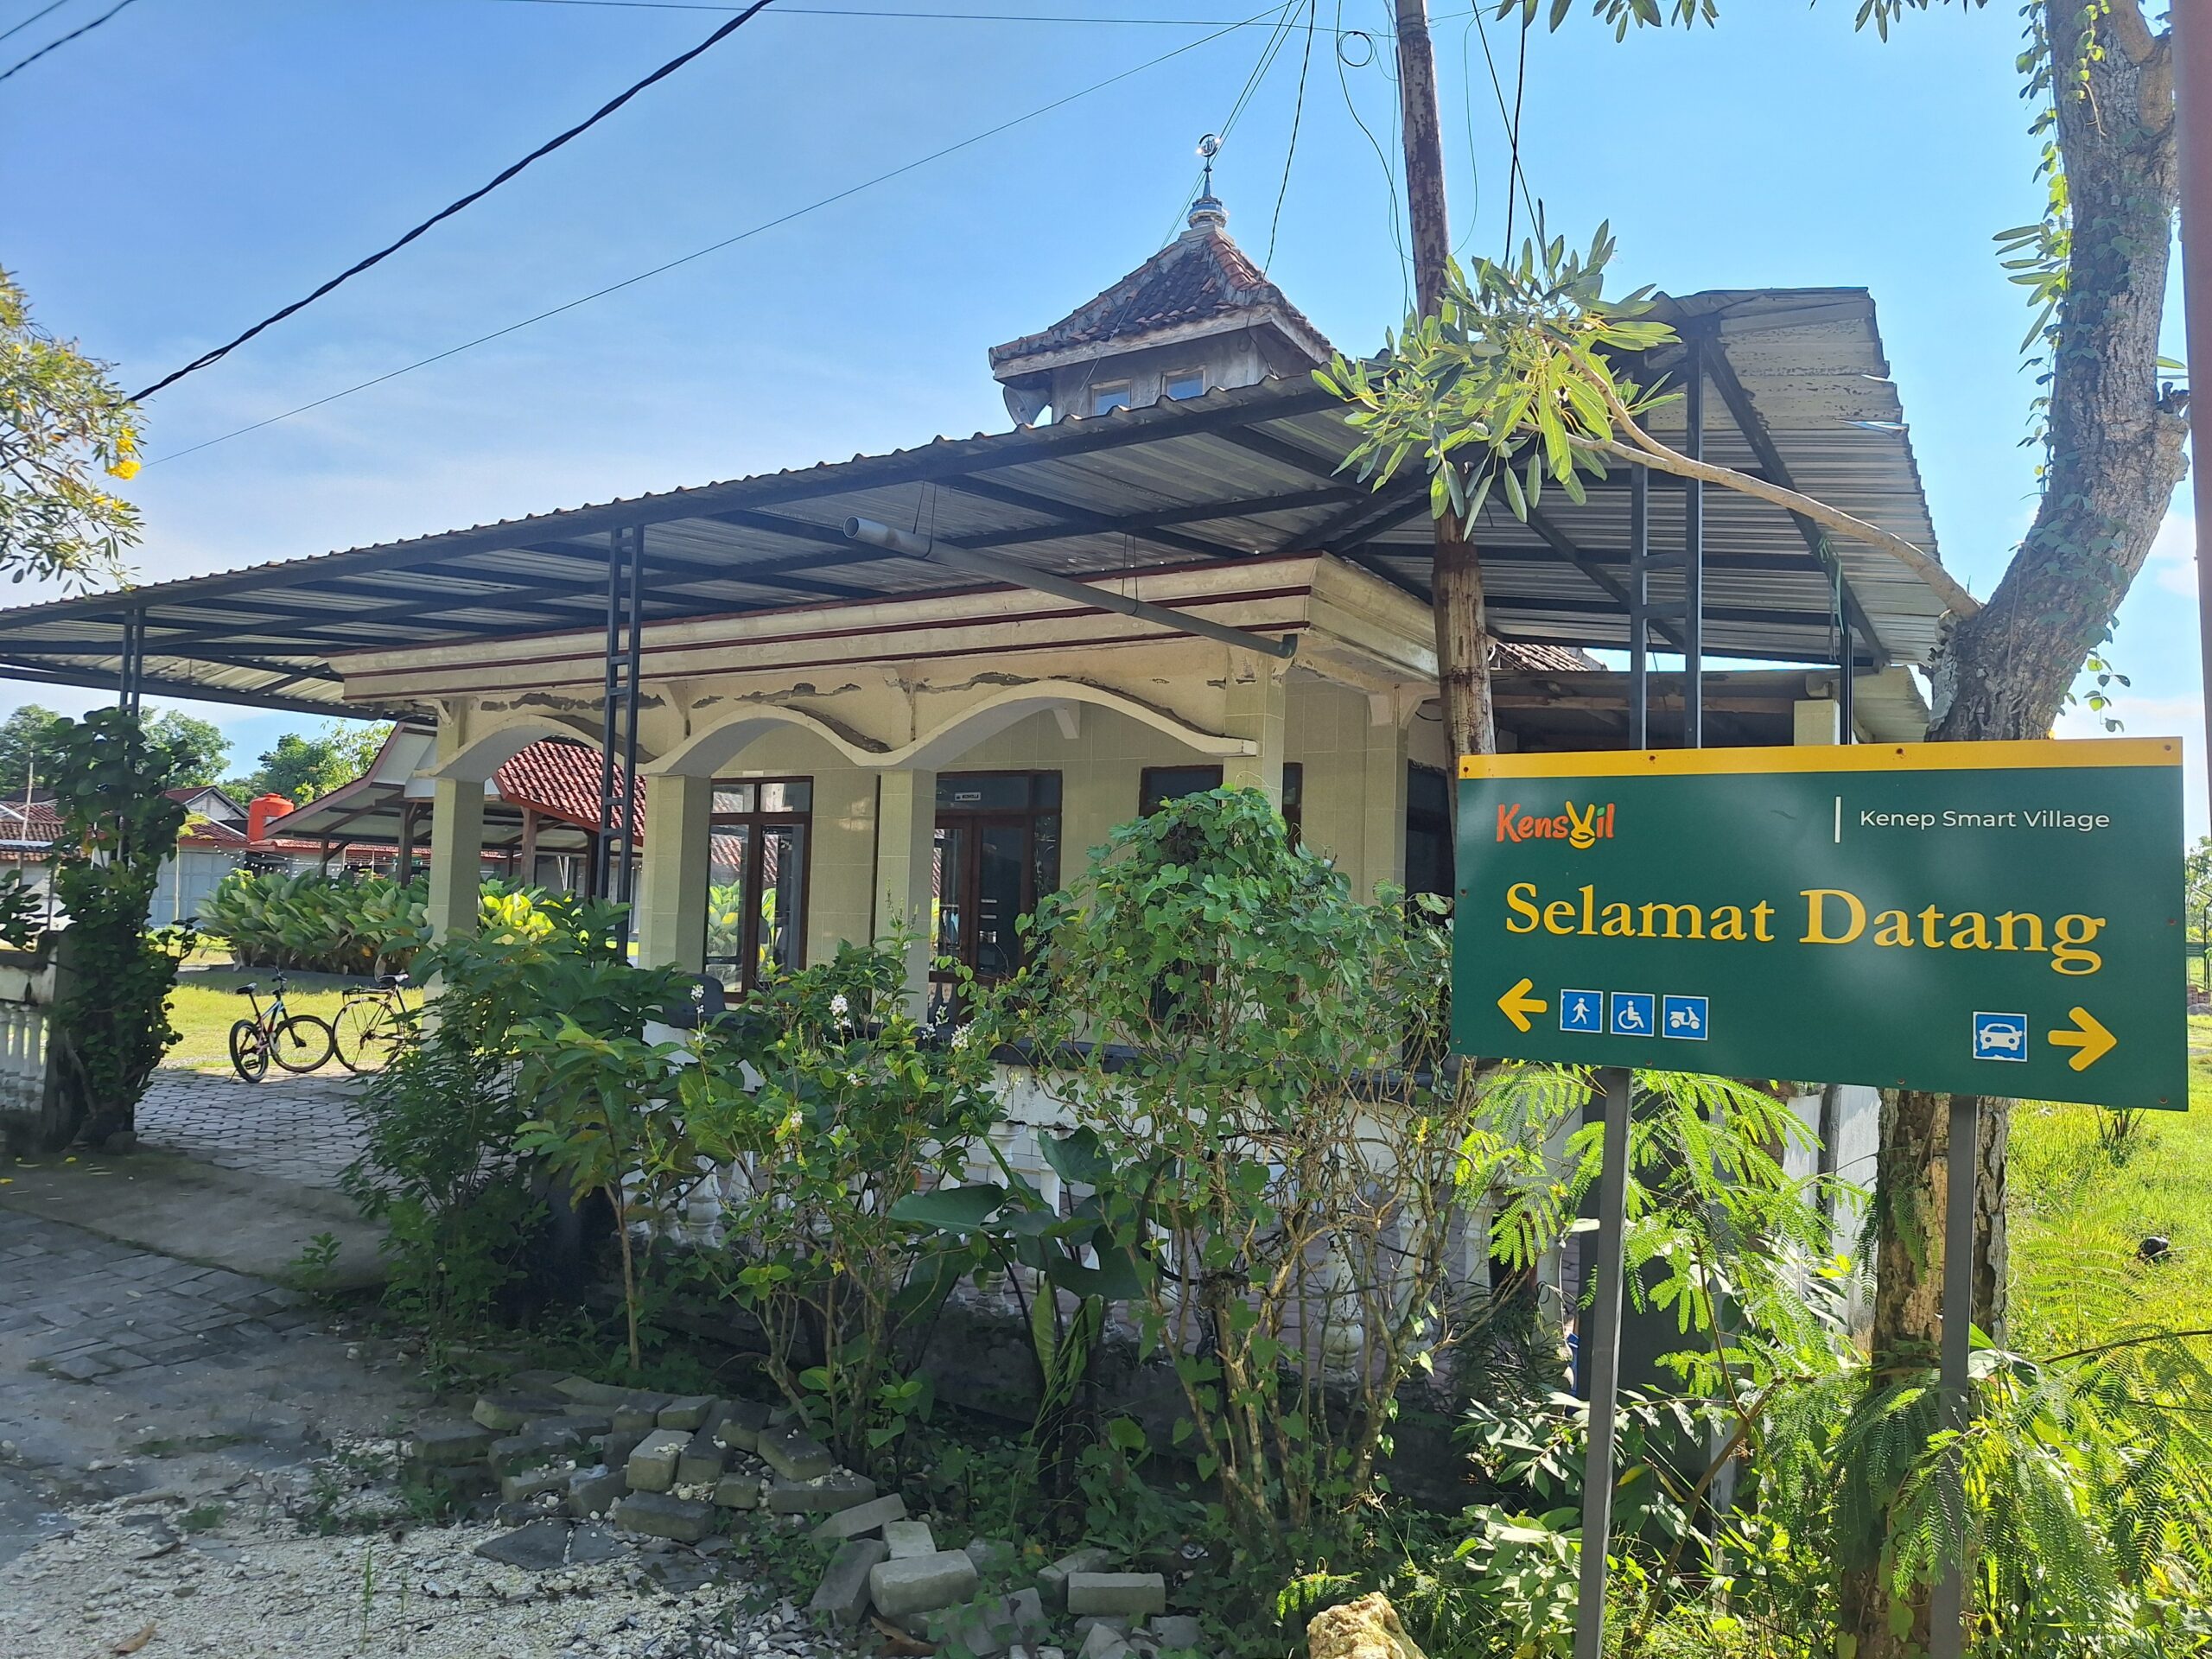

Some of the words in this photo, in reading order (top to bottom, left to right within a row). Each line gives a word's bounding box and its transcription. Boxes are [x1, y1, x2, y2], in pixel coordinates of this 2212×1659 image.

[1859, 810, 1936, 831] Kenep
[1942, 810, 2018, 828] Smart
[2023, 809, 2110, 833] Village
[1505, 882, 1775, 942] Selamat
[1799, 890, 2107, 976] Datang
